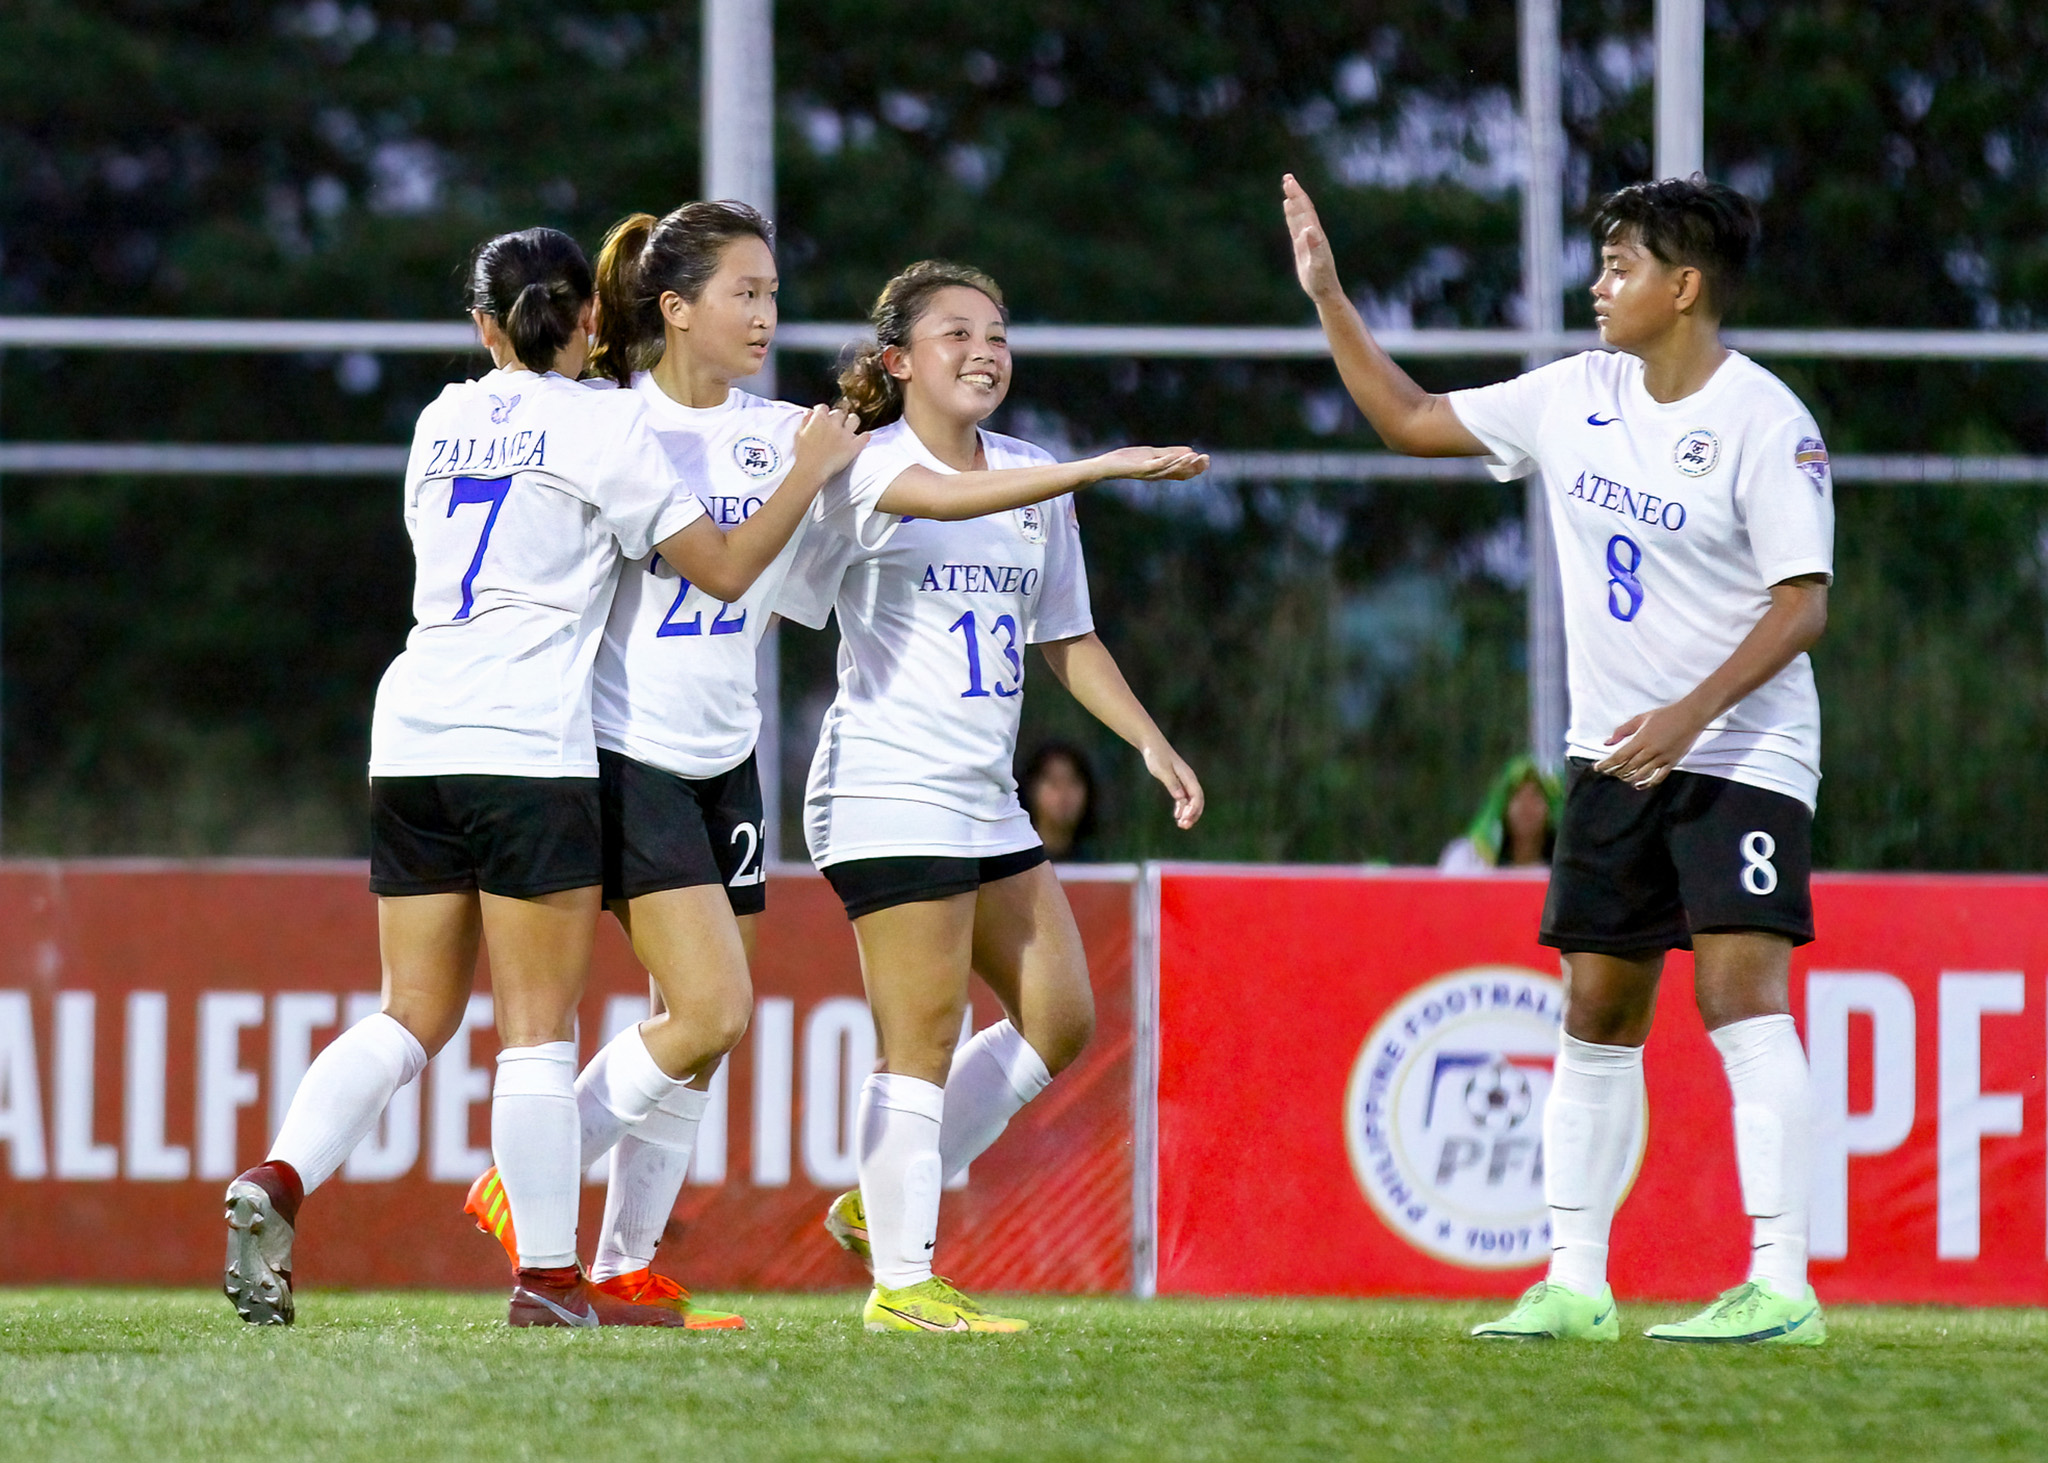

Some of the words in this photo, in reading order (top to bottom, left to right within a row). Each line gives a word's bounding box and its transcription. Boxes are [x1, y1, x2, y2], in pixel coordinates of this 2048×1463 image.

[424, 430, 546, 476] ZALAMEA
[1568, 470, 1686, 531] ATENEO
[447, 476, 512, 620] 7
[919, 564, 1038, 595] ATENEO
[1606, 534, 1644, 622] 8
[949, 610, 1020, 698] 13
[729, 819, 766, 887] 2
[1739, 831, 1778, 895] 8
[1806, 970, 2048, 1260] PF
